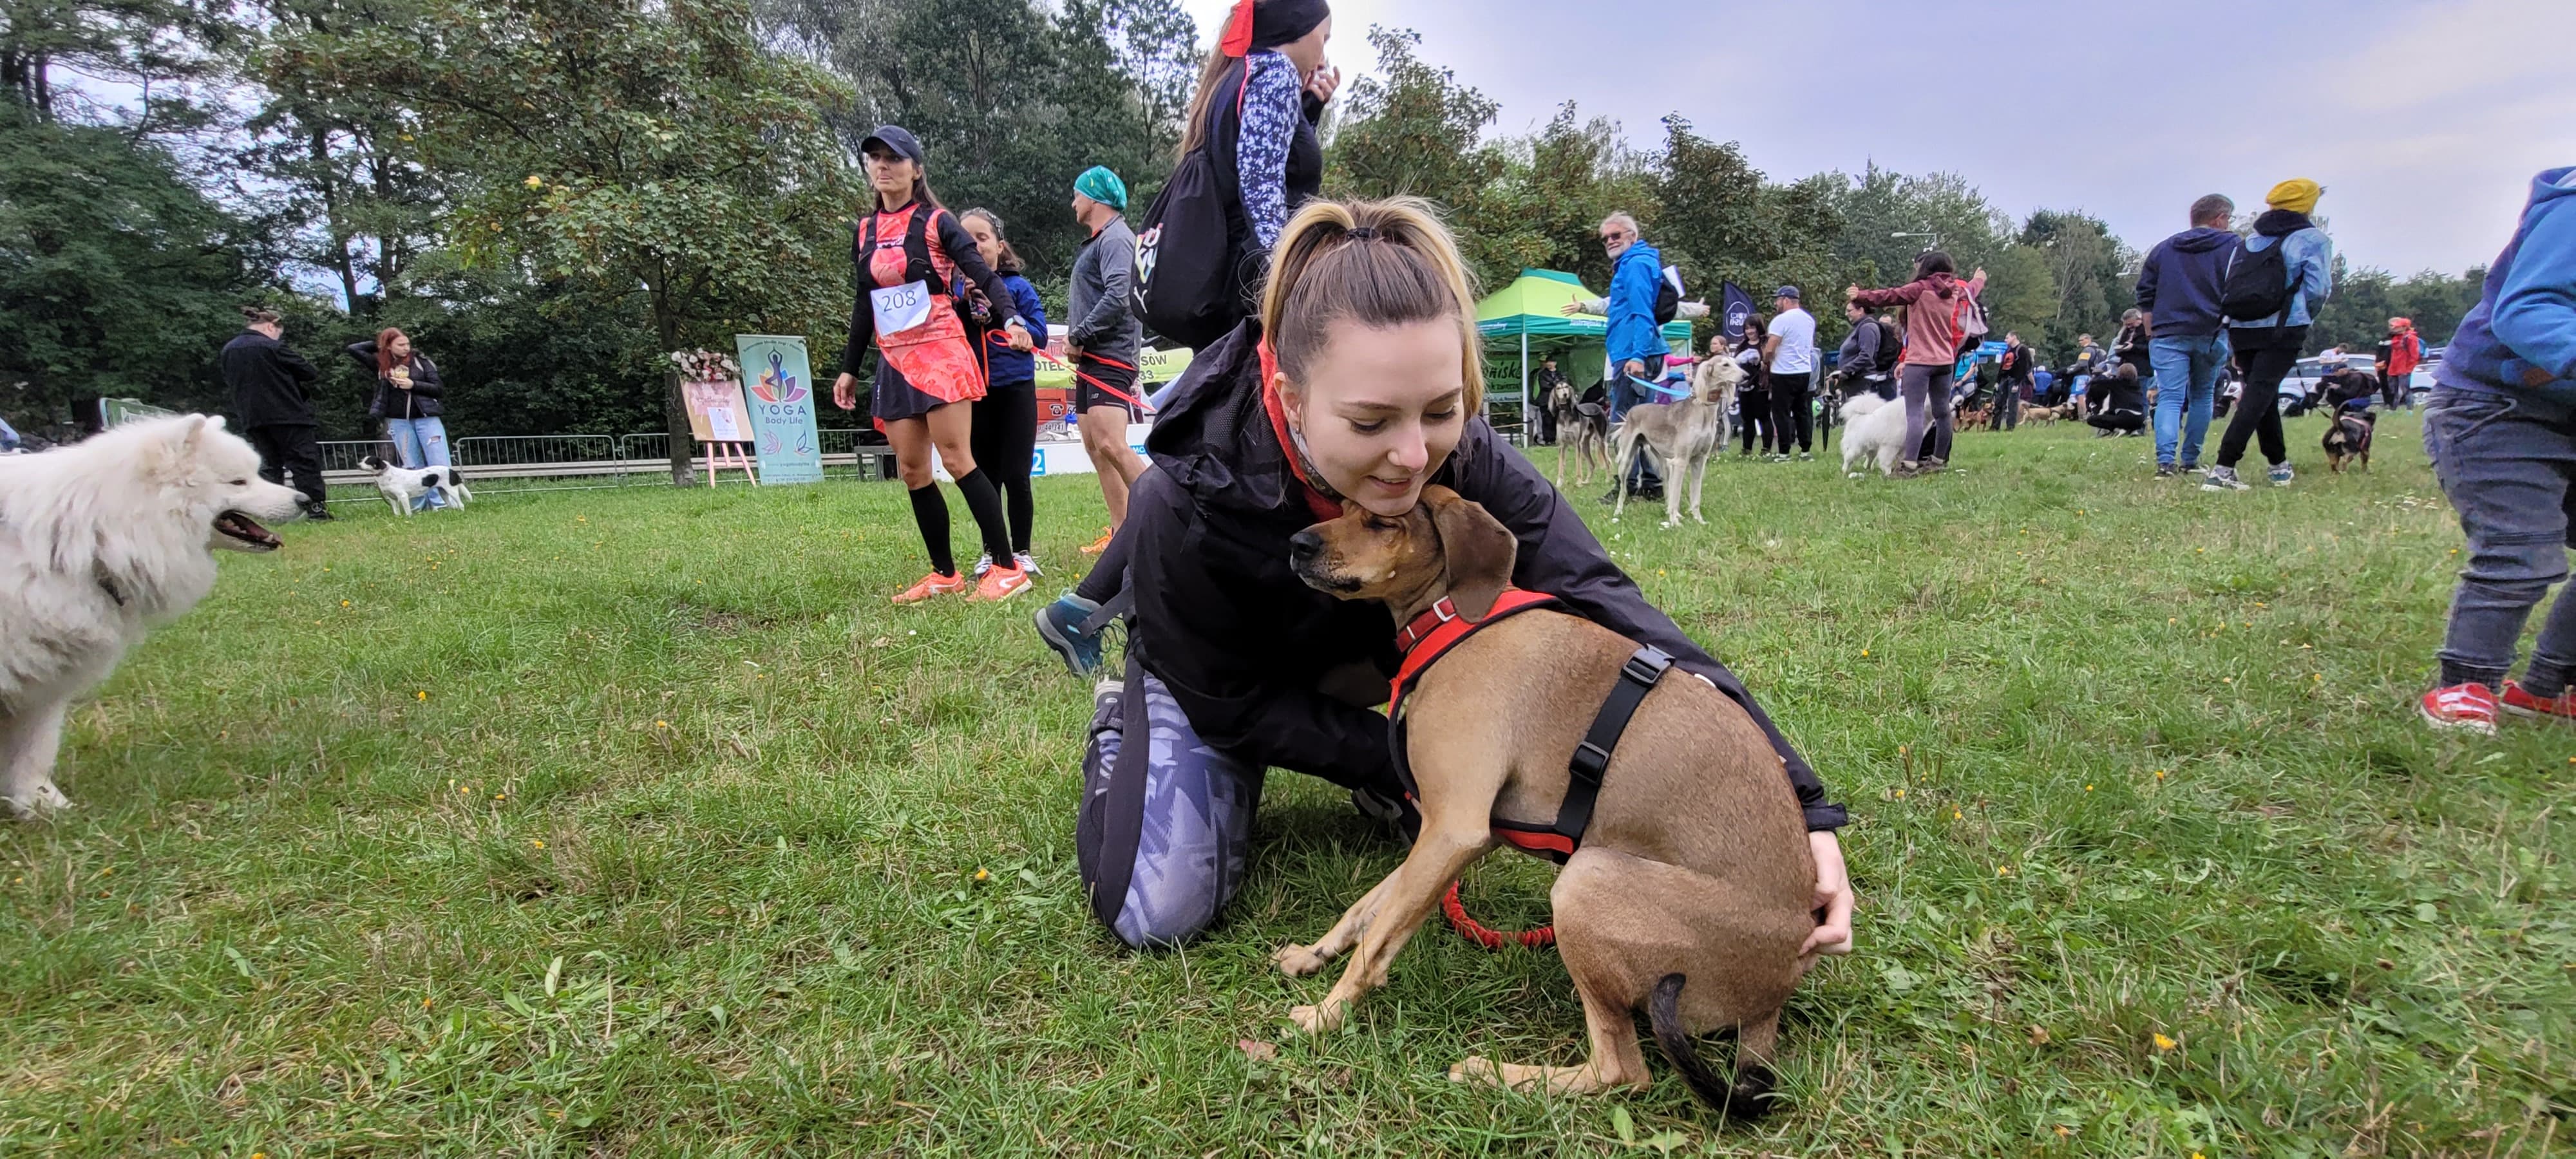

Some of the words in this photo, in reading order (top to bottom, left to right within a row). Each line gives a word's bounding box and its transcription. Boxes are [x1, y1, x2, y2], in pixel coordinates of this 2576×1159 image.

[882, 290, 916, 312] 208
[759, 404, 806, 415] YOGA
[765, 417, 786, 425] Body
